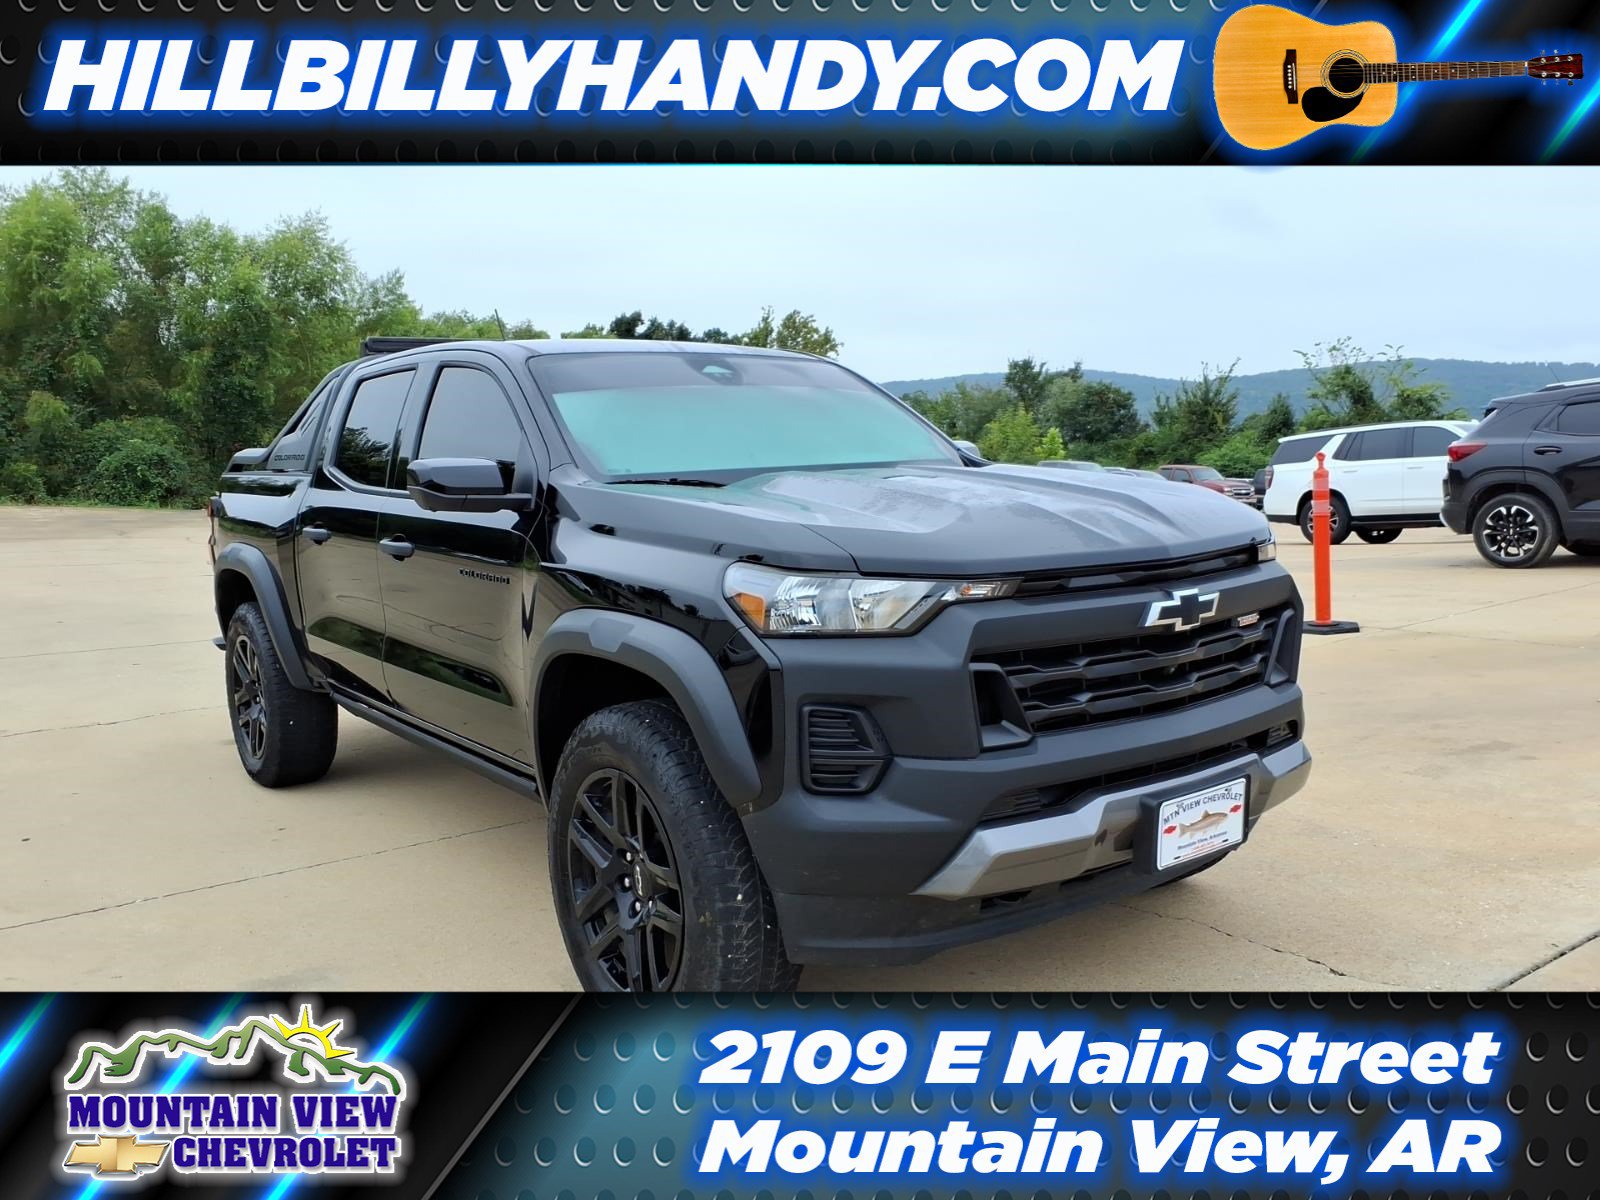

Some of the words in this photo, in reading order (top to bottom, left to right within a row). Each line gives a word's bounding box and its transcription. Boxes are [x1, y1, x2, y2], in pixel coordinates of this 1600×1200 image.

[1163, 809, 1181, 824] MTN
[1182, 799, 1202, 813] VIEW
[1202, 792, 1243, 805] CHEVROLET
